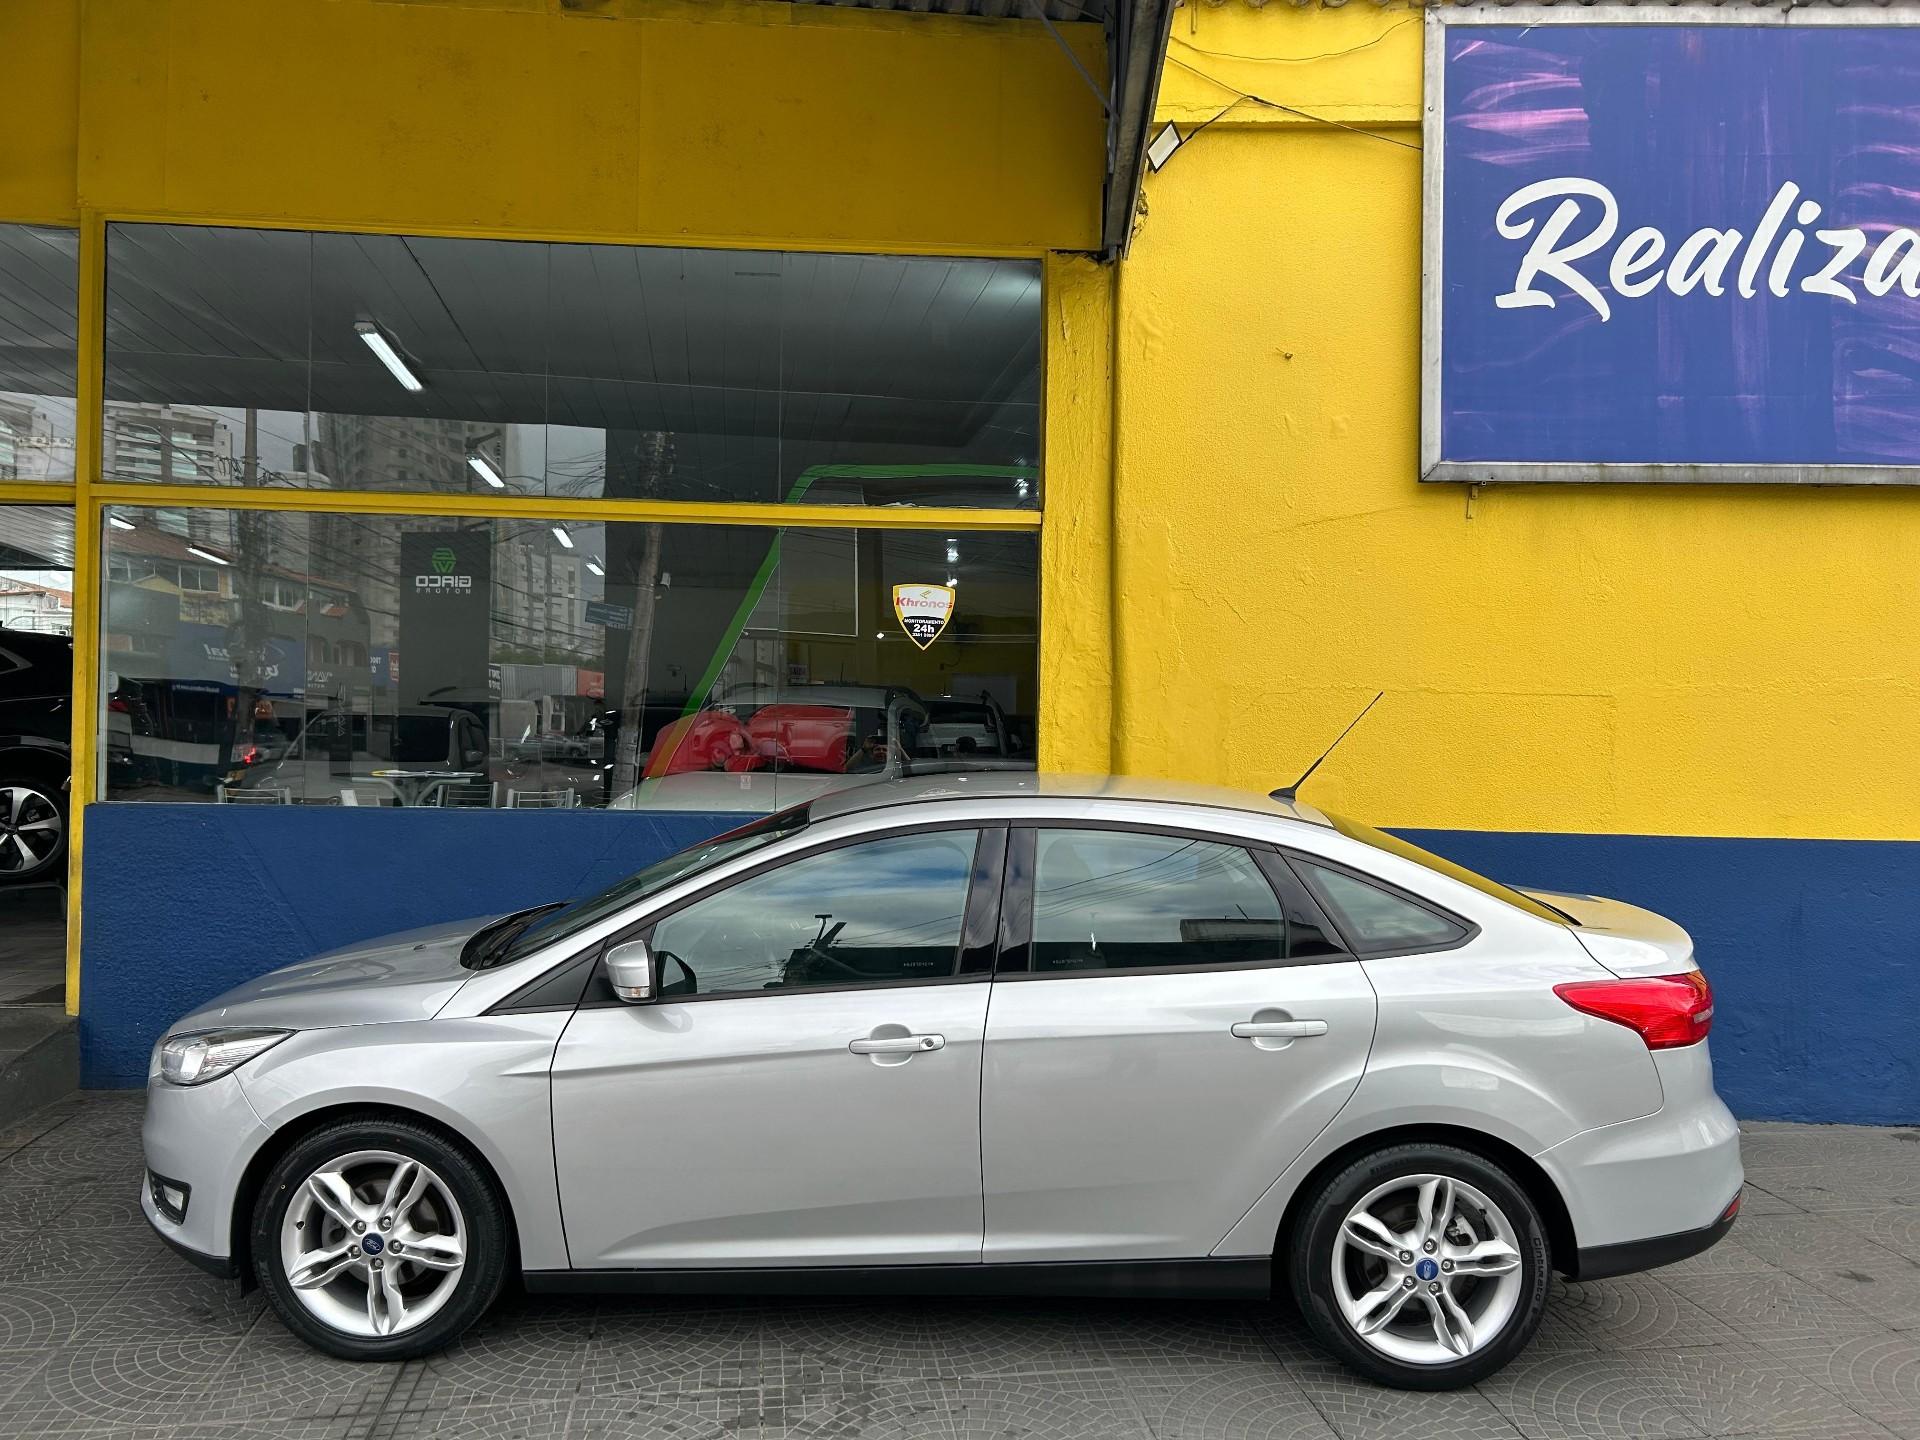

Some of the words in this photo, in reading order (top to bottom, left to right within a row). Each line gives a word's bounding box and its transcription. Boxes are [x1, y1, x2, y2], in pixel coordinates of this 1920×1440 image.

[1495, 177, 1920, 322] Realiza
[896, 597, 953, 609] Khronos
[913, 624, 935, 633] 24h
[1532, 1237, 1545, 1302] Cinturato
